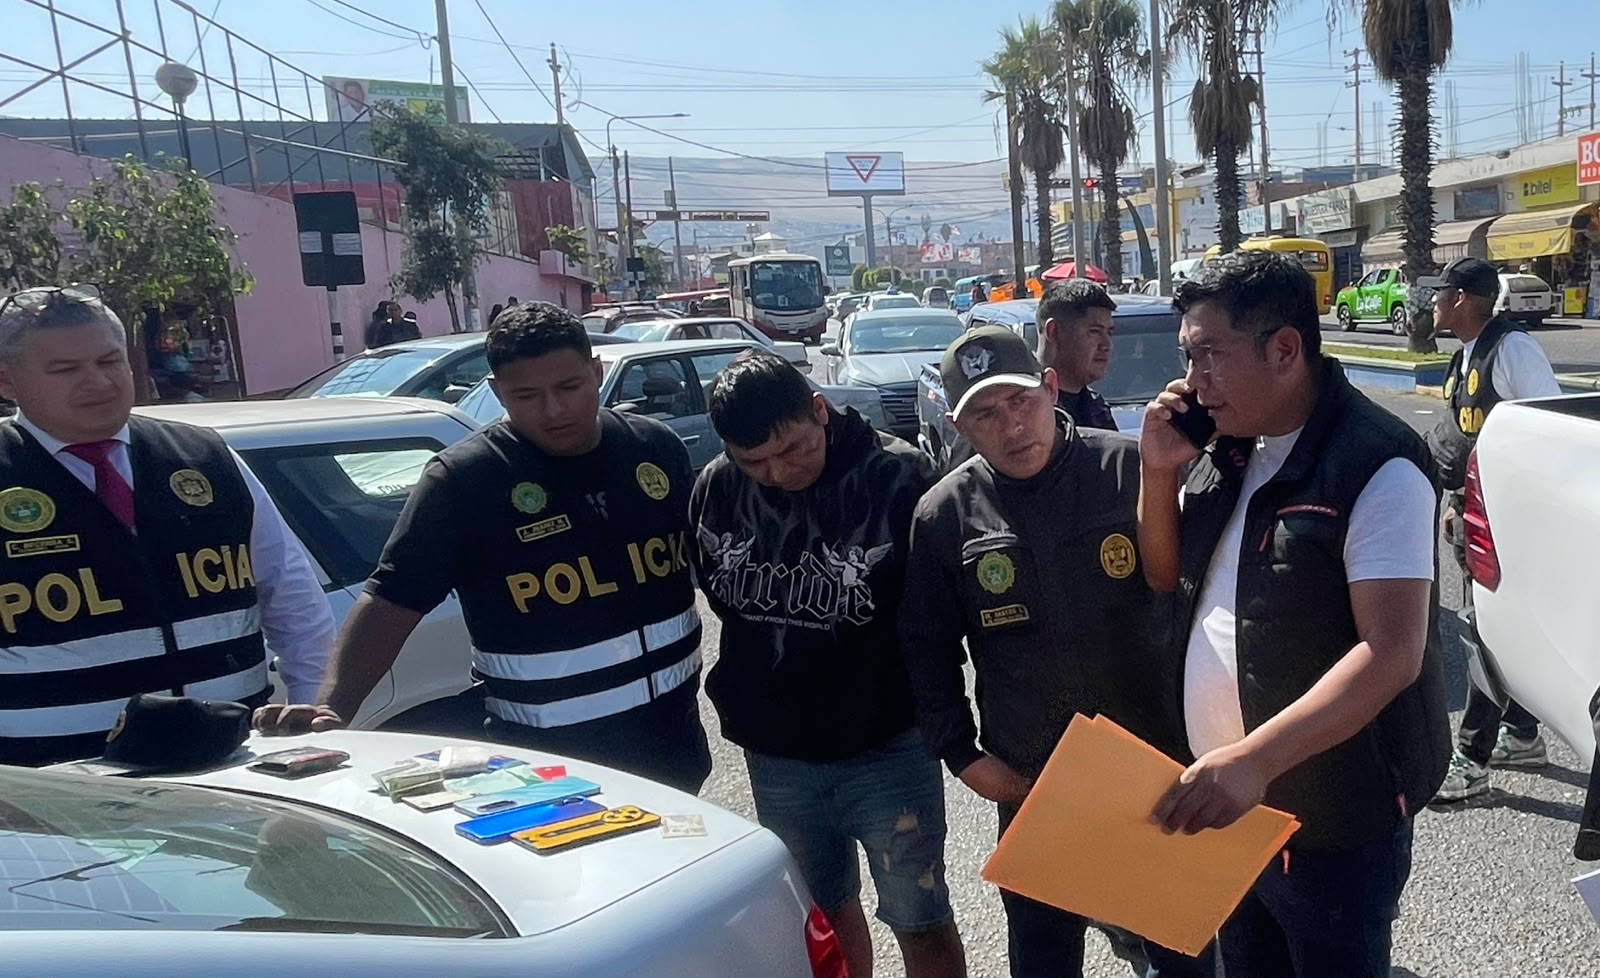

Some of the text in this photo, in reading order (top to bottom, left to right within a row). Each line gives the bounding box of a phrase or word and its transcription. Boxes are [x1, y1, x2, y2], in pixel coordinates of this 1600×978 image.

[1530, 179, 1552, 196] bitel
[0, 567, 124, 634] POL
[505, 555, 619, 613] POL
[804, 621, 831, 631] WORLD
